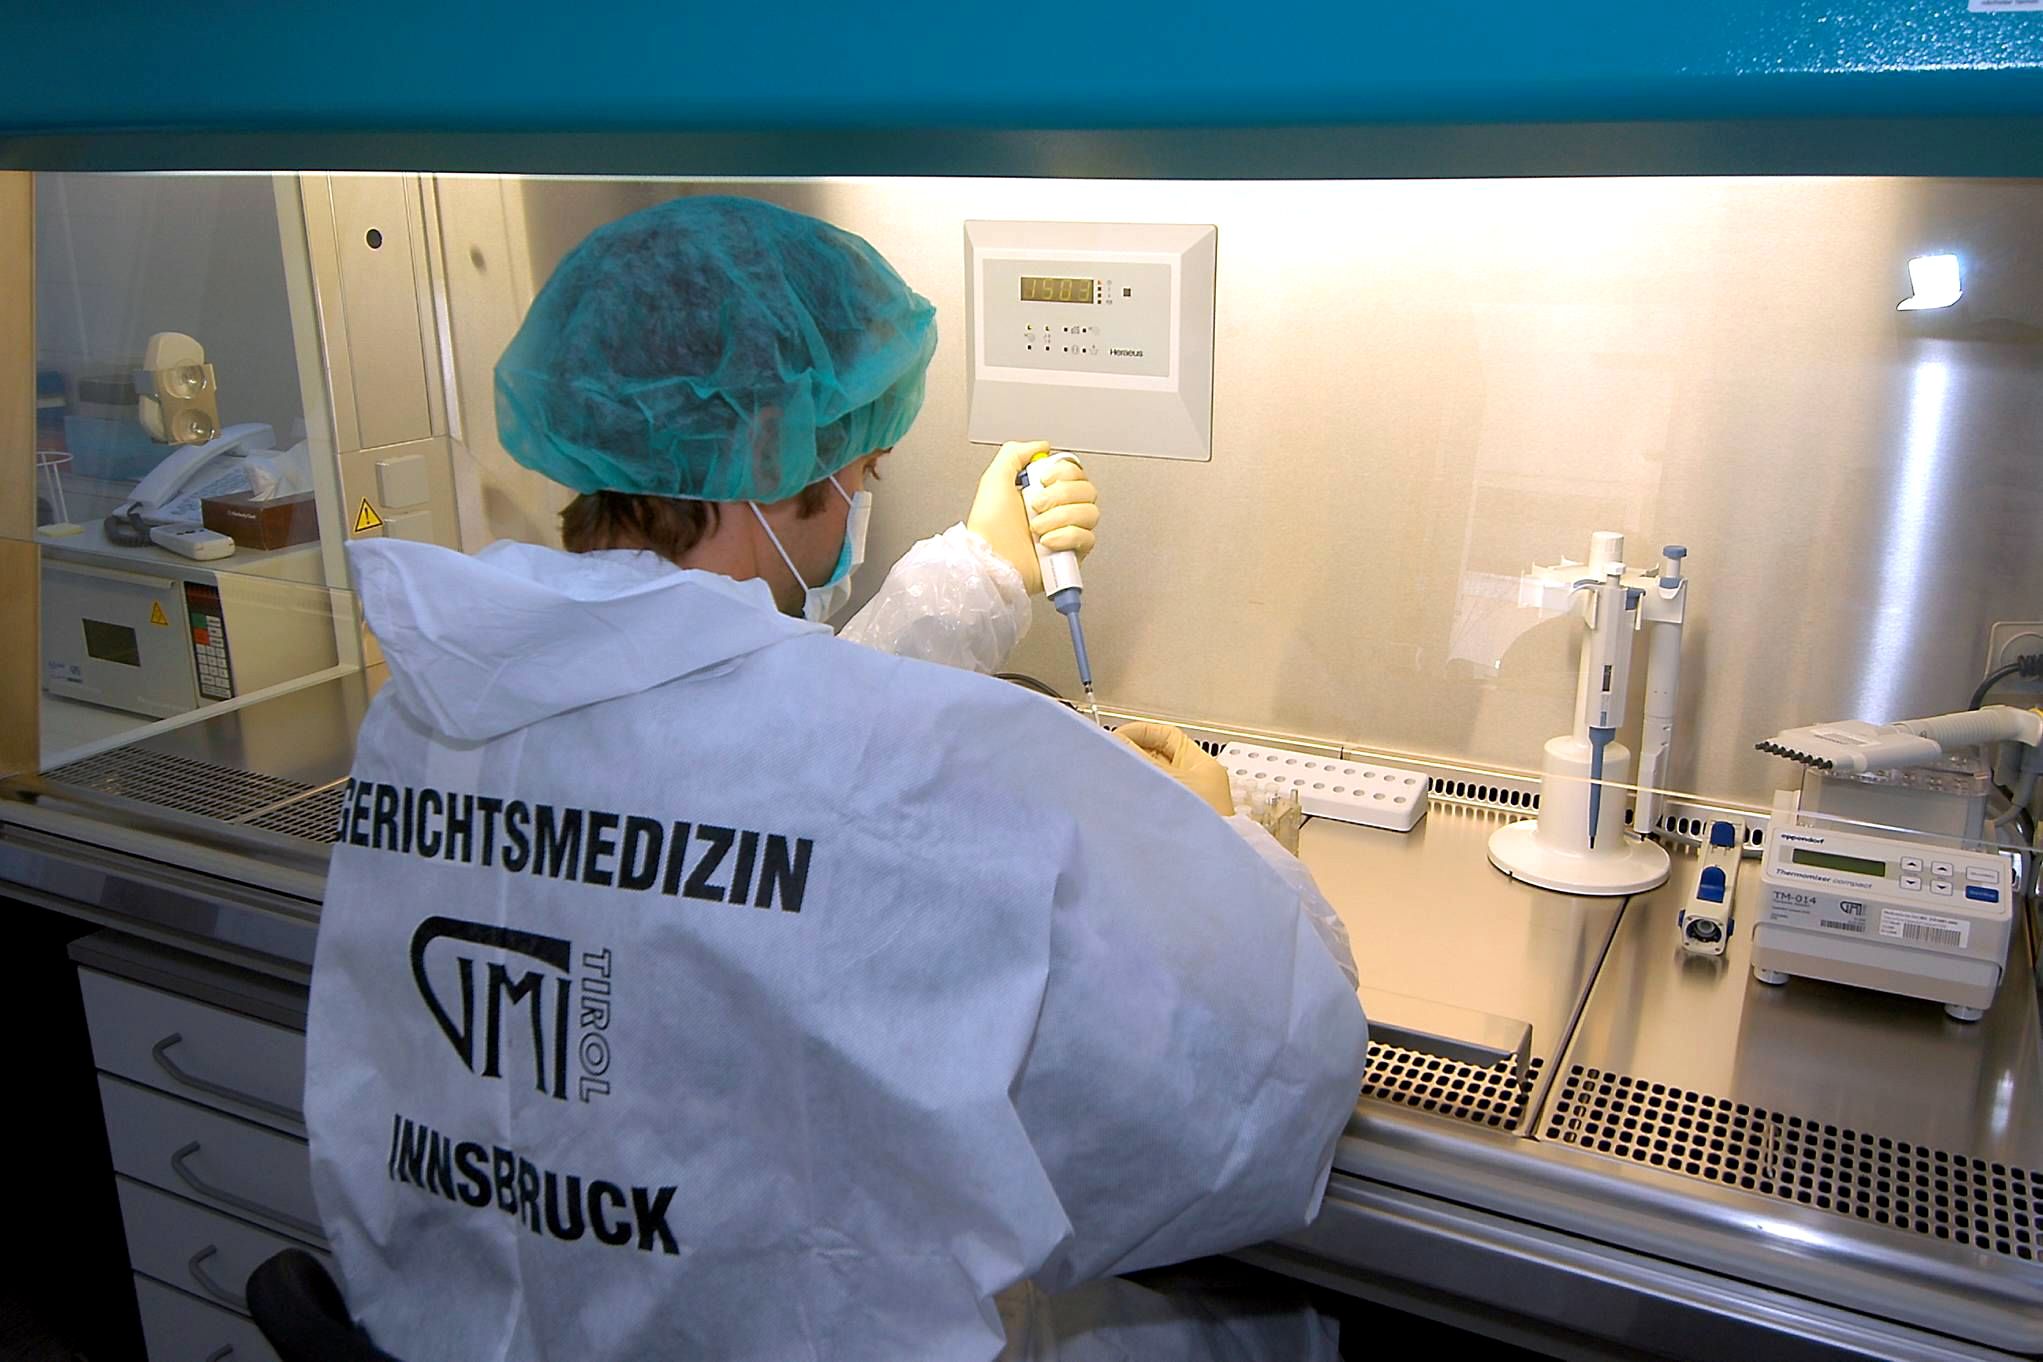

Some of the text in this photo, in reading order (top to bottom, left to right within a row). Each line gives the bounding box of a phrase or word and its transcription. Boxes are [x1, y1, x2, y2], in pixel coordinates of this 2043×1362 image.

[1109, 347, 1144, 358] Heraeus
[1780, 833, 1825, 845] eppendorf
[1776, 868, 1873, 889] Thermomixer compact
[1773, 890, 1817, 905] TM-014
[578, 947, 613, 1104] TIROL
[388, 1113, 681, 1257] INNSBRUCK
